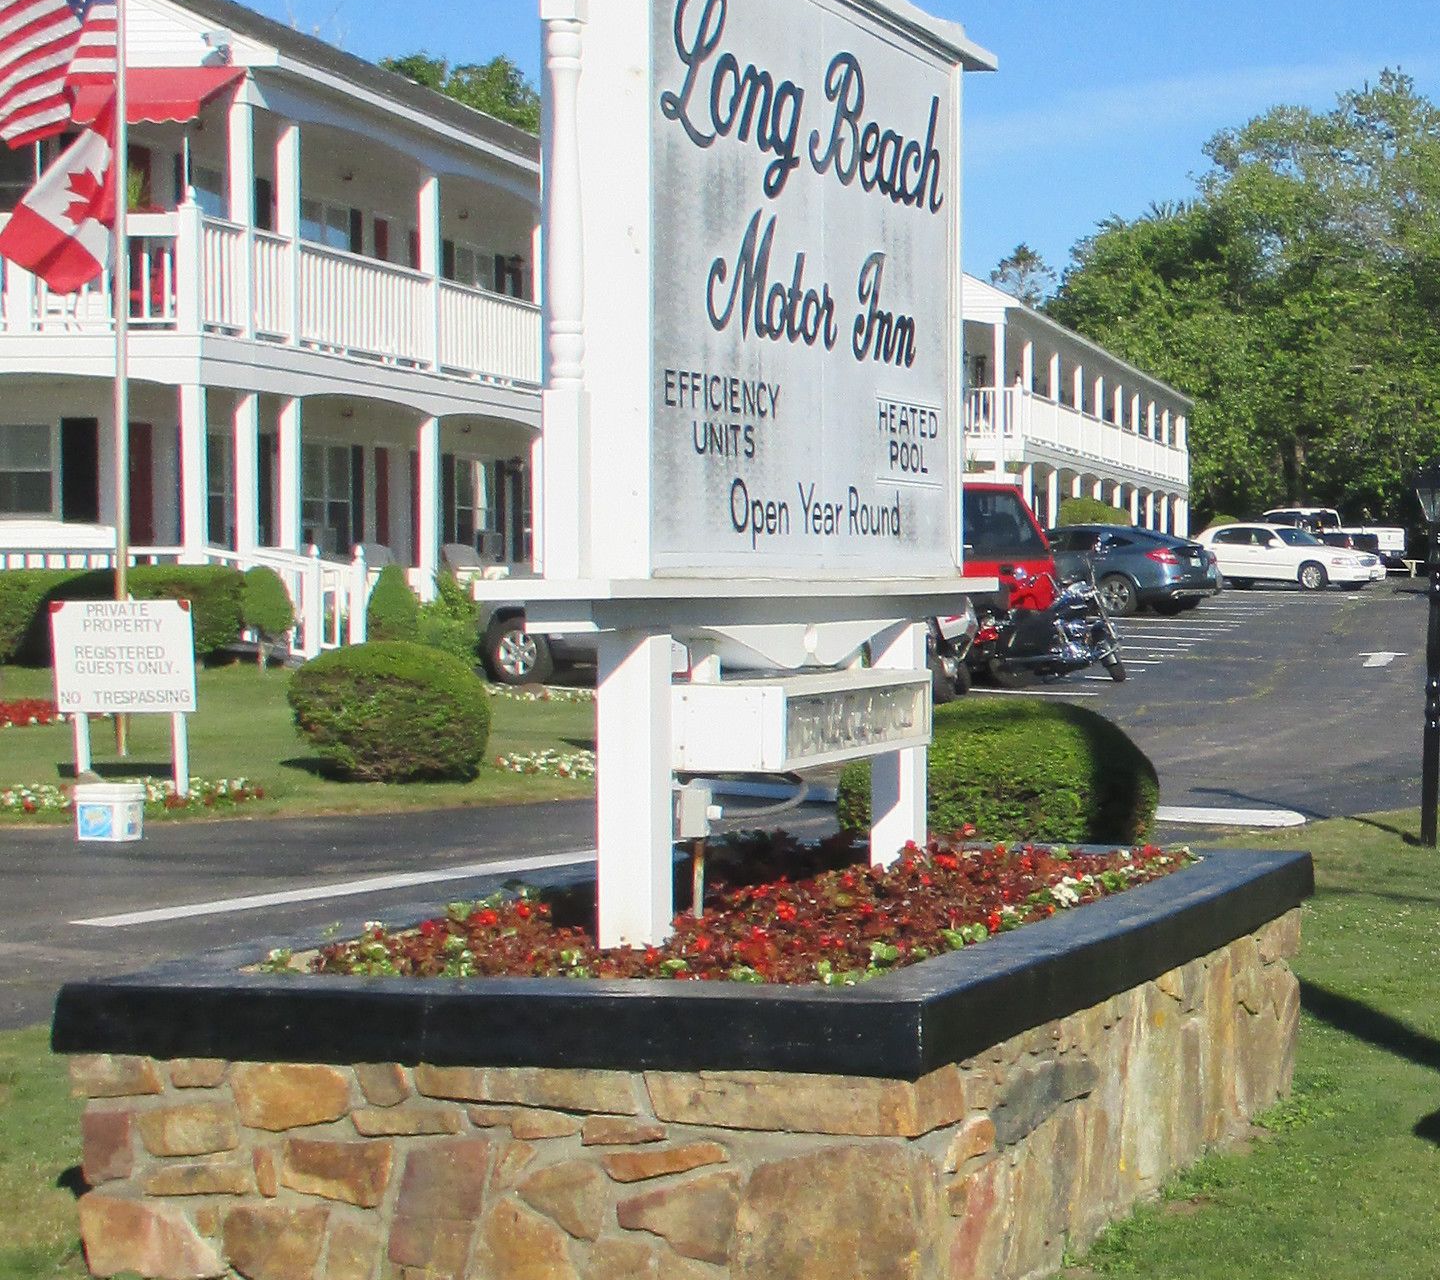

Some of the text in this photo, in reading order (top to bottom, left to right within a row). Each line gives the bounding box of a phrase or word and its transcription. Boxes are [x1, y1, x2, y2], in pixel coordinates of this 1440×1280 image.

[808, 51, 943, 214] Beach
[706, 207, 916, 368] Motor Inn
[664, 369, 780, 419] EFFICIENCY
[878, 402, 939, 439] HEATED
[694, 421, 756, 459] UNITS
[889, 441, 929, 474] POOL
[730, 477, 900, 550] Open Year Round
[83, 619, 162, 632] PROPERTY
[86, 603, 149, 617] PRIVATE
[75, 646, 165, 660] REGISTERED
[75, 661, 134, 674] GUESTS
[61, 690, 190, 705] NO TRESPASSING
